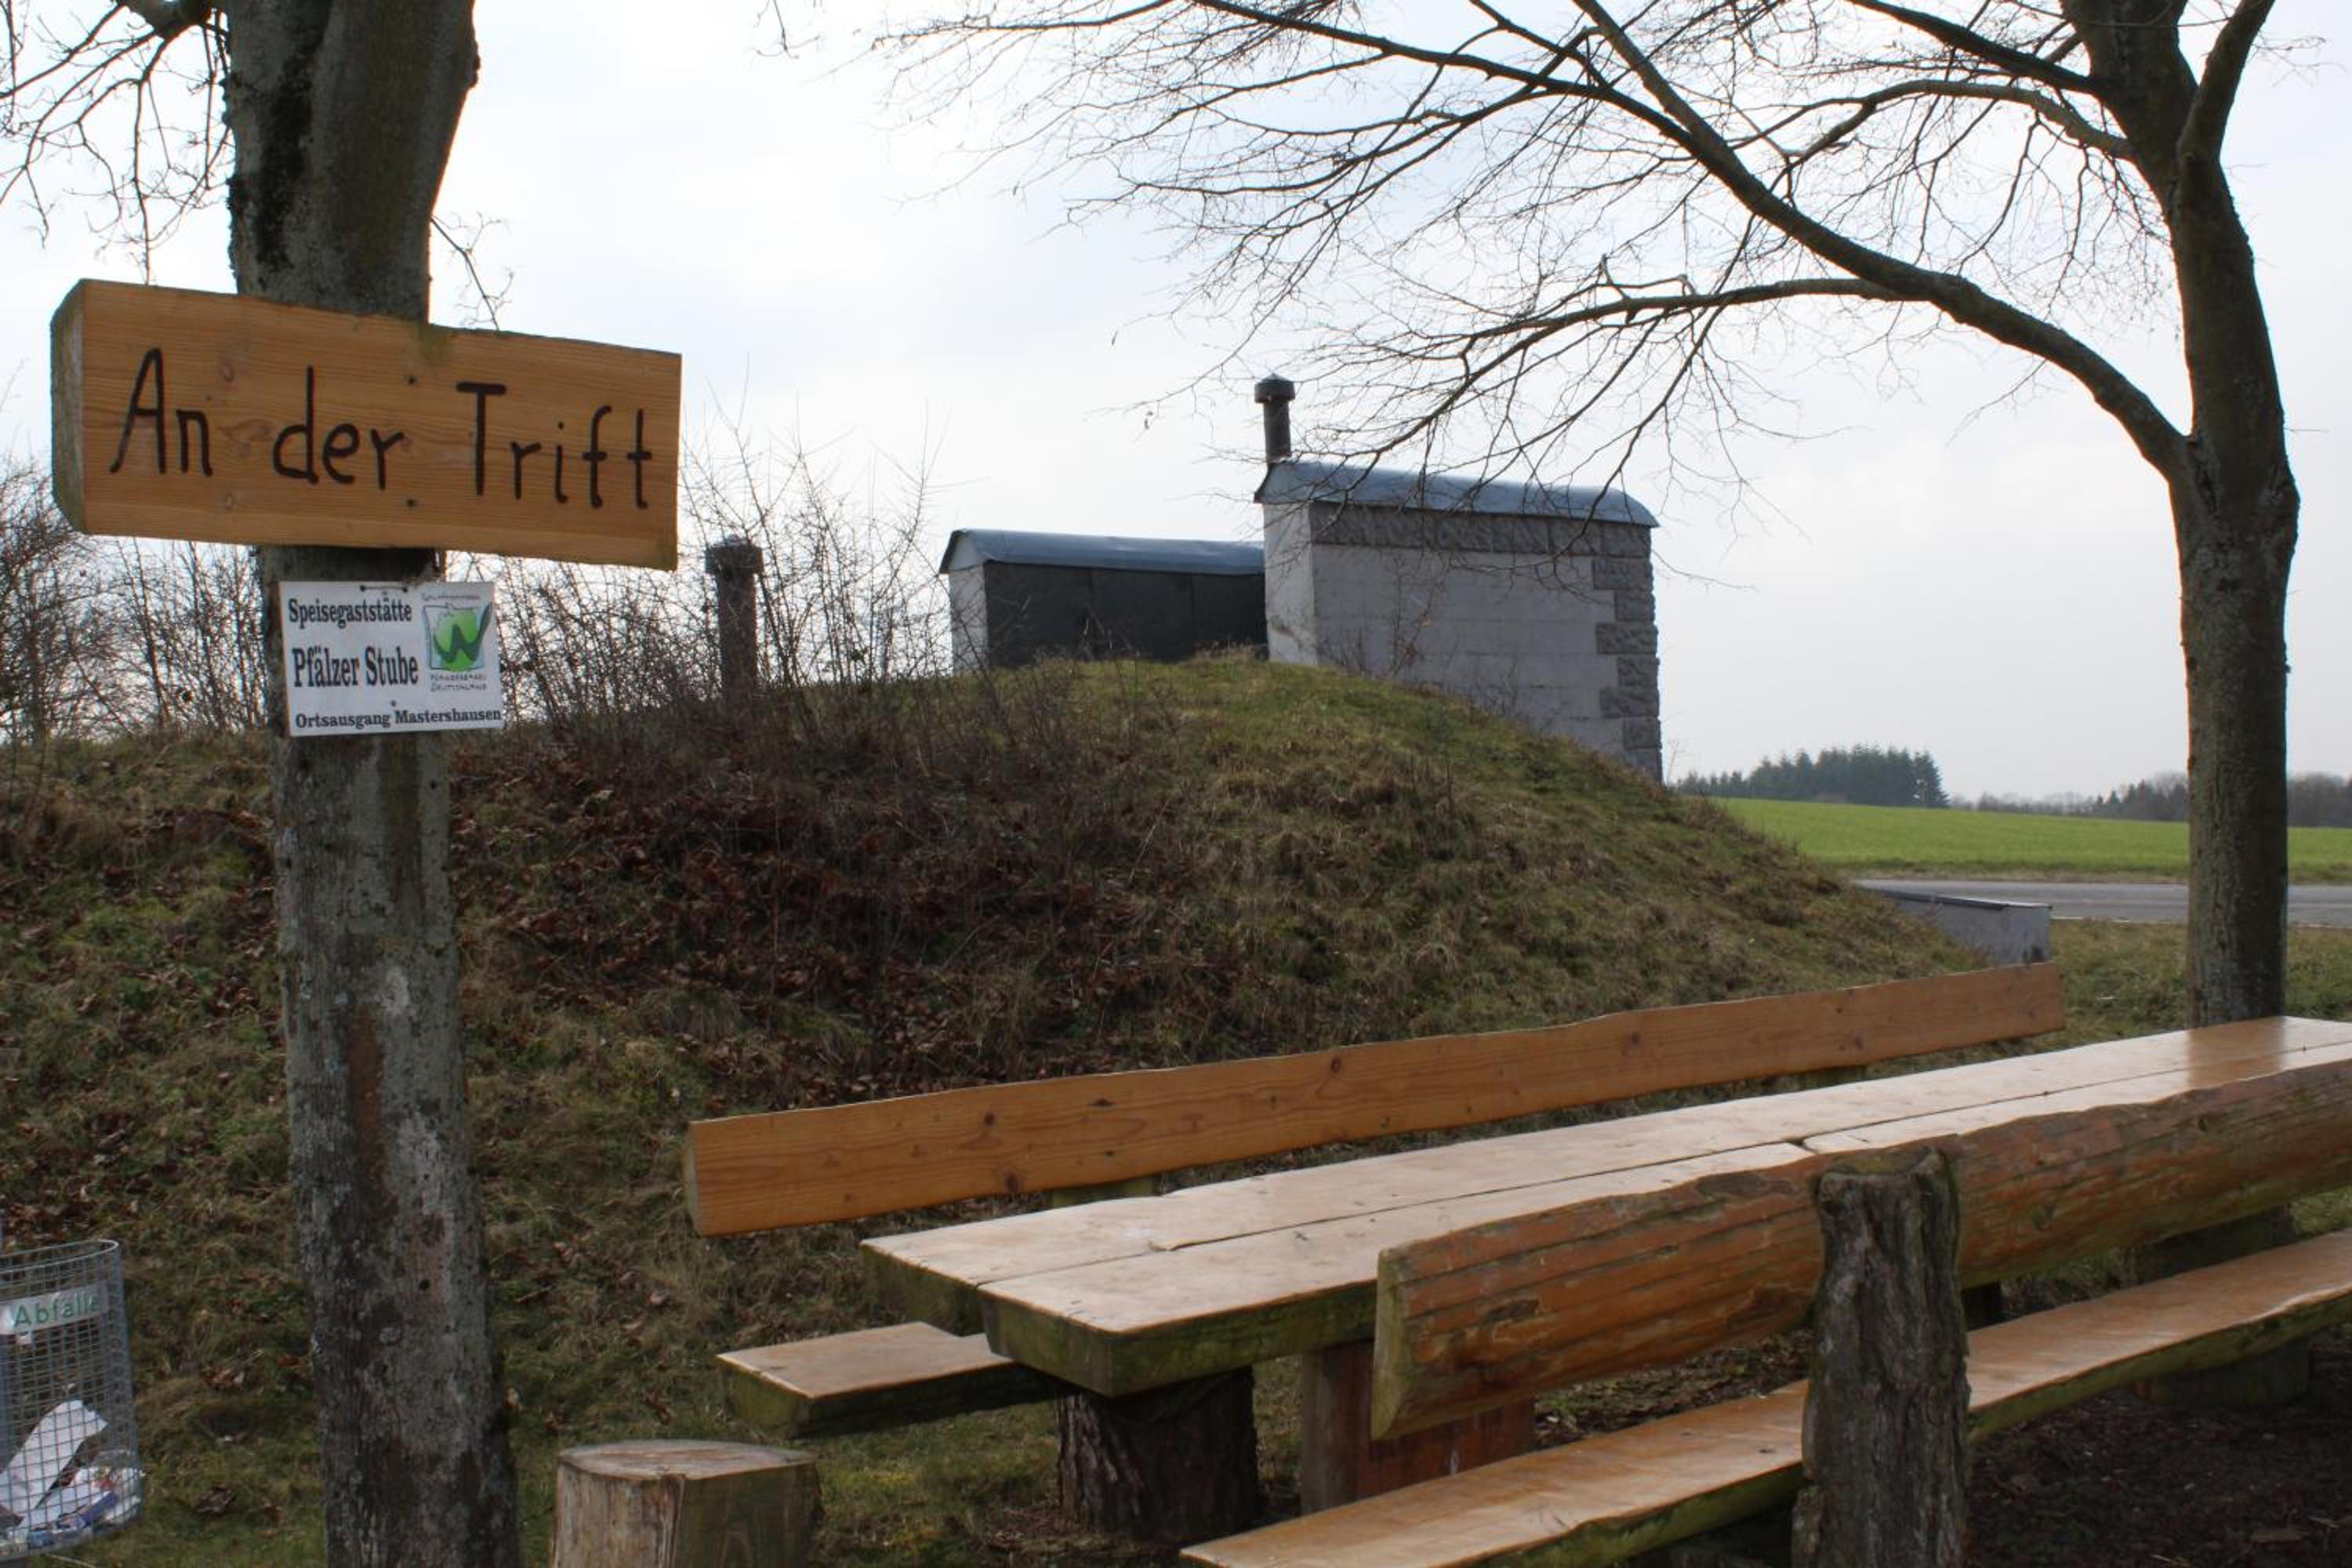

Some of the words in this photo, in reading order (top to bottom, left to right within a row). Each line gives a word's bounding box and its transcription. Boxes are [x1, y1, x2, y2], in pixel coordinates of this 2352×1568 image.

[110, 347, 212, 476] An
[273, 366, 405, 490] der
[456, 383, 653, 508] Trift
[288, 597, 412, 629] Speisegaststätte
[292, 645, 360, 687] Pfälzer
[365, 644, 419, 686] Stube
[296, 712, 391, 729] Ortsausgang
[394, 708, 502, 724] Mastershausen
